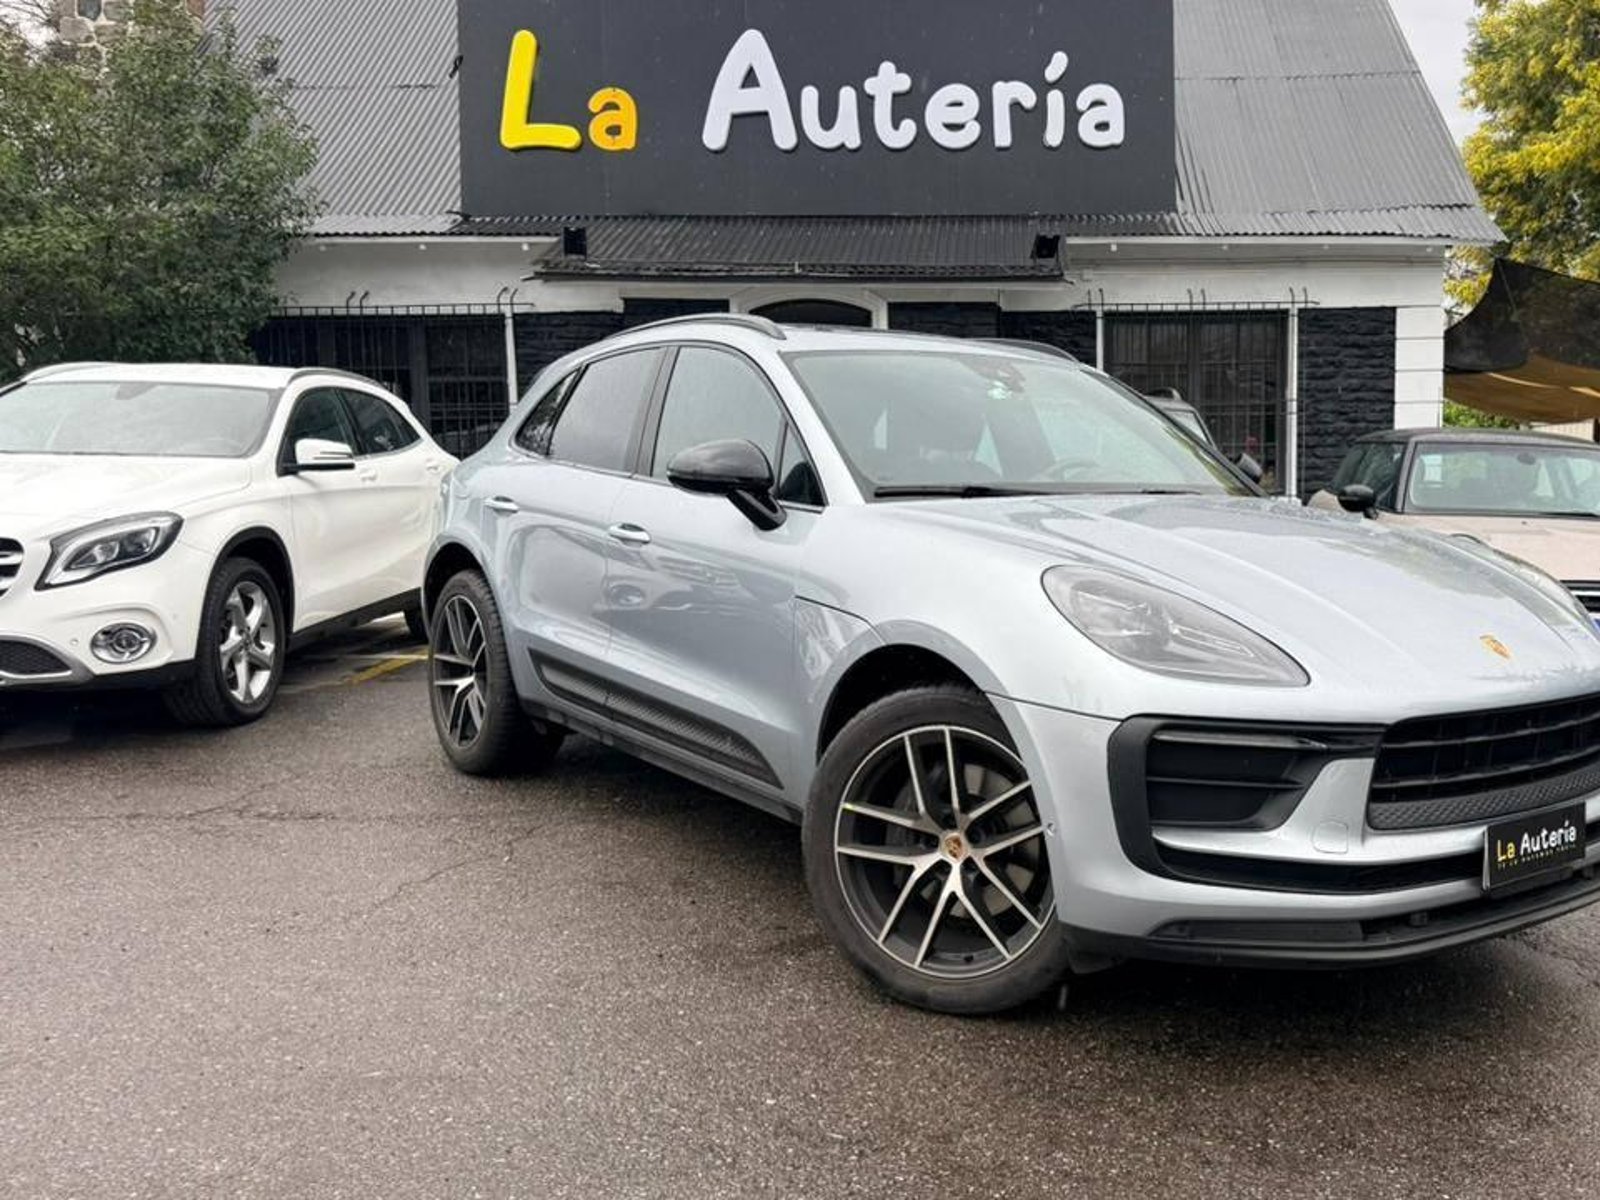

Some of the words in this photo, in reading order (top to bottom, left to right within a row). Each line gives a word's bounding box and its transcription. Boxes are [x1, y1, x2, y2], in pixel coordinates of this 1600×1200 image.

[499, 30, 638, 151] La
[701, 29, 1126, 152] Autería
[1497, 839, 1516, 862] La
[1520, 820, 1577, 856] Autería
